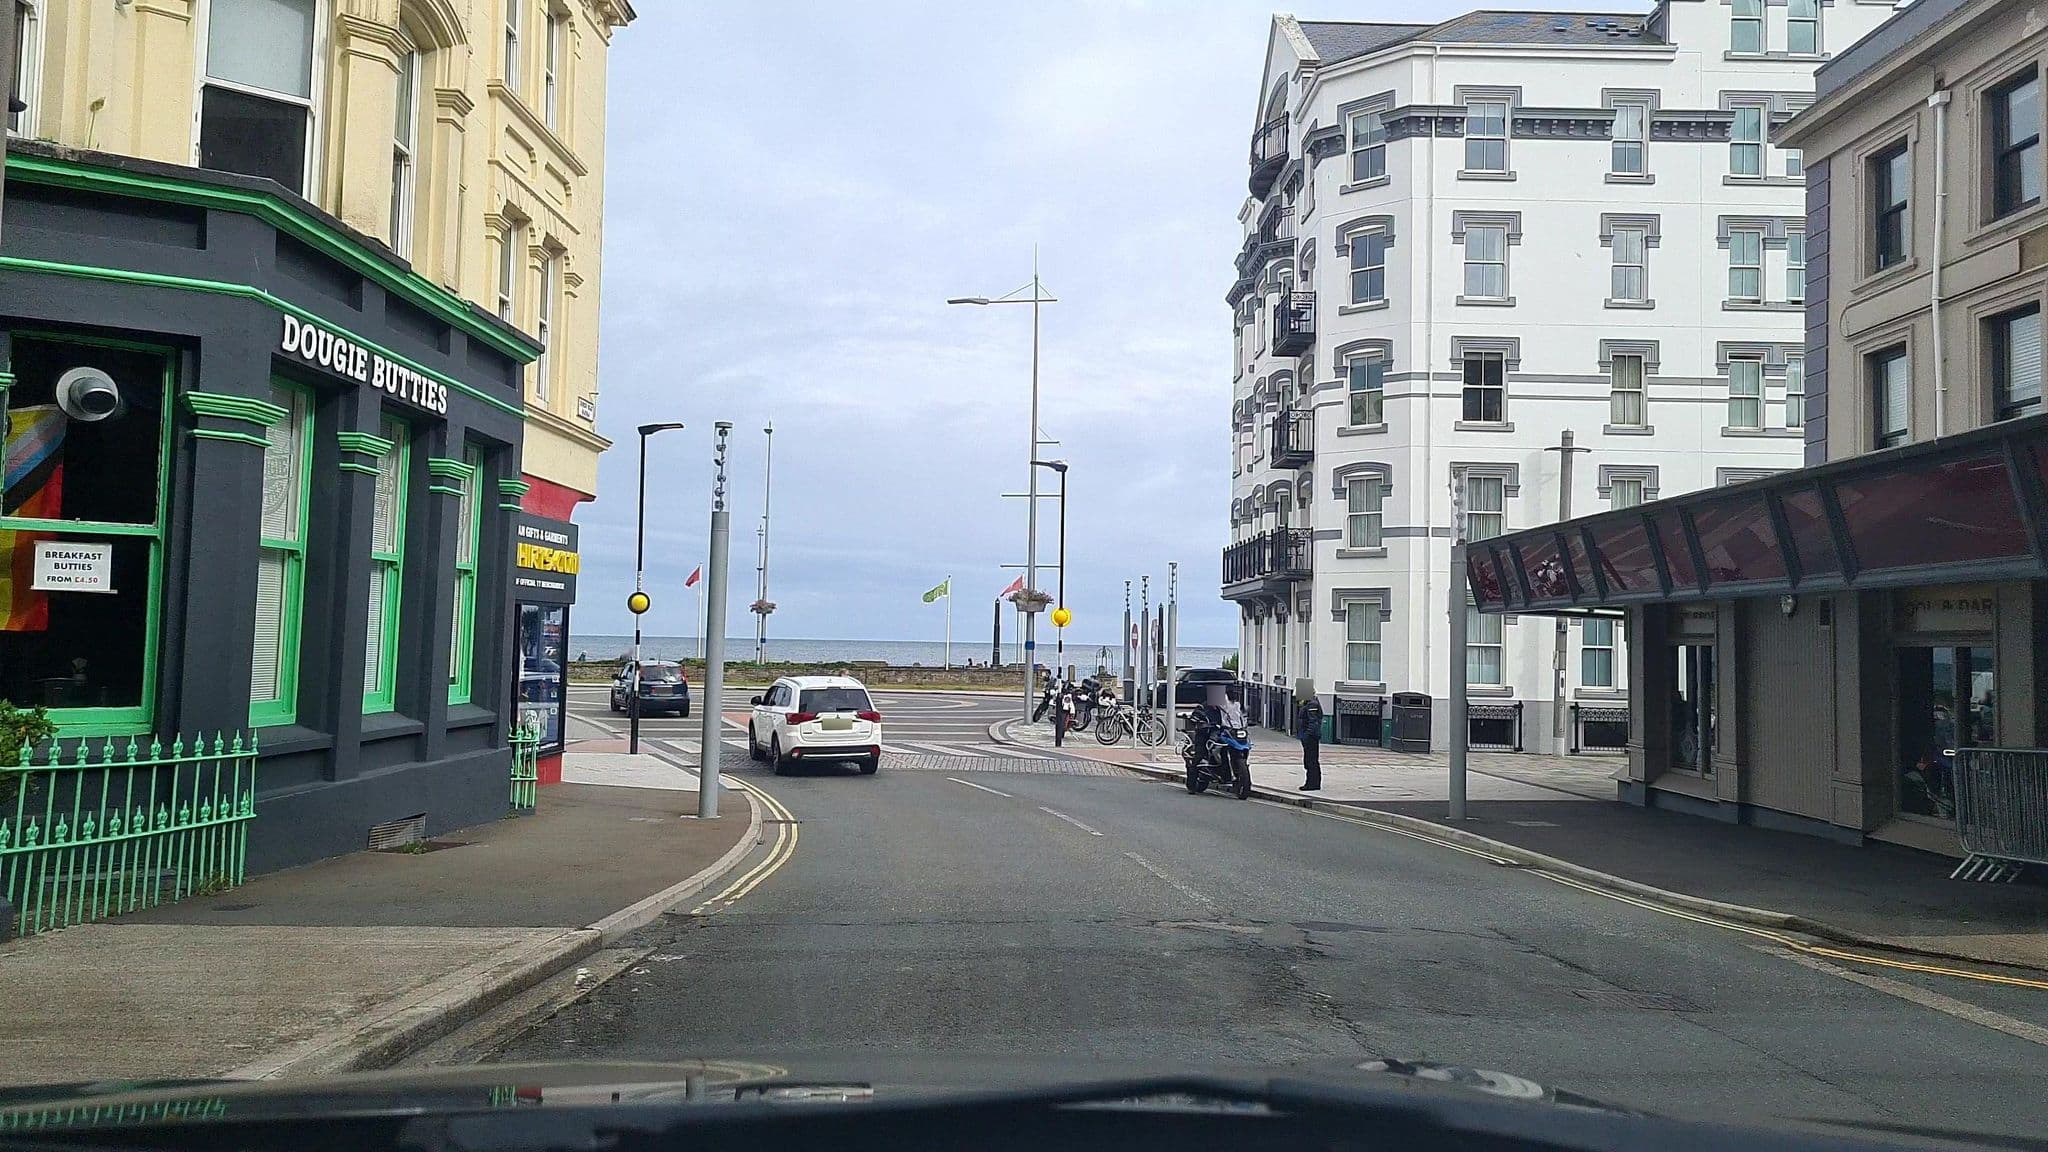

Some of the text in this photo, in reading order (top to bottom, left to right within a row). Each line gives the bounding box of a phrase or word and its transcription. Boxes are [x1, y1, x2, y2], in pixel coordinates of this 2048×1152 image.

[282, 313, 448, 415] DOUGIE BUTTIES
[526, 526, 540, 540] GIFTS
[45, 551, 103, 560] BREAKFAST
[54, 562, 93, 571] BUTTIES
[46, 575, 98, 584] FROM £4.50
